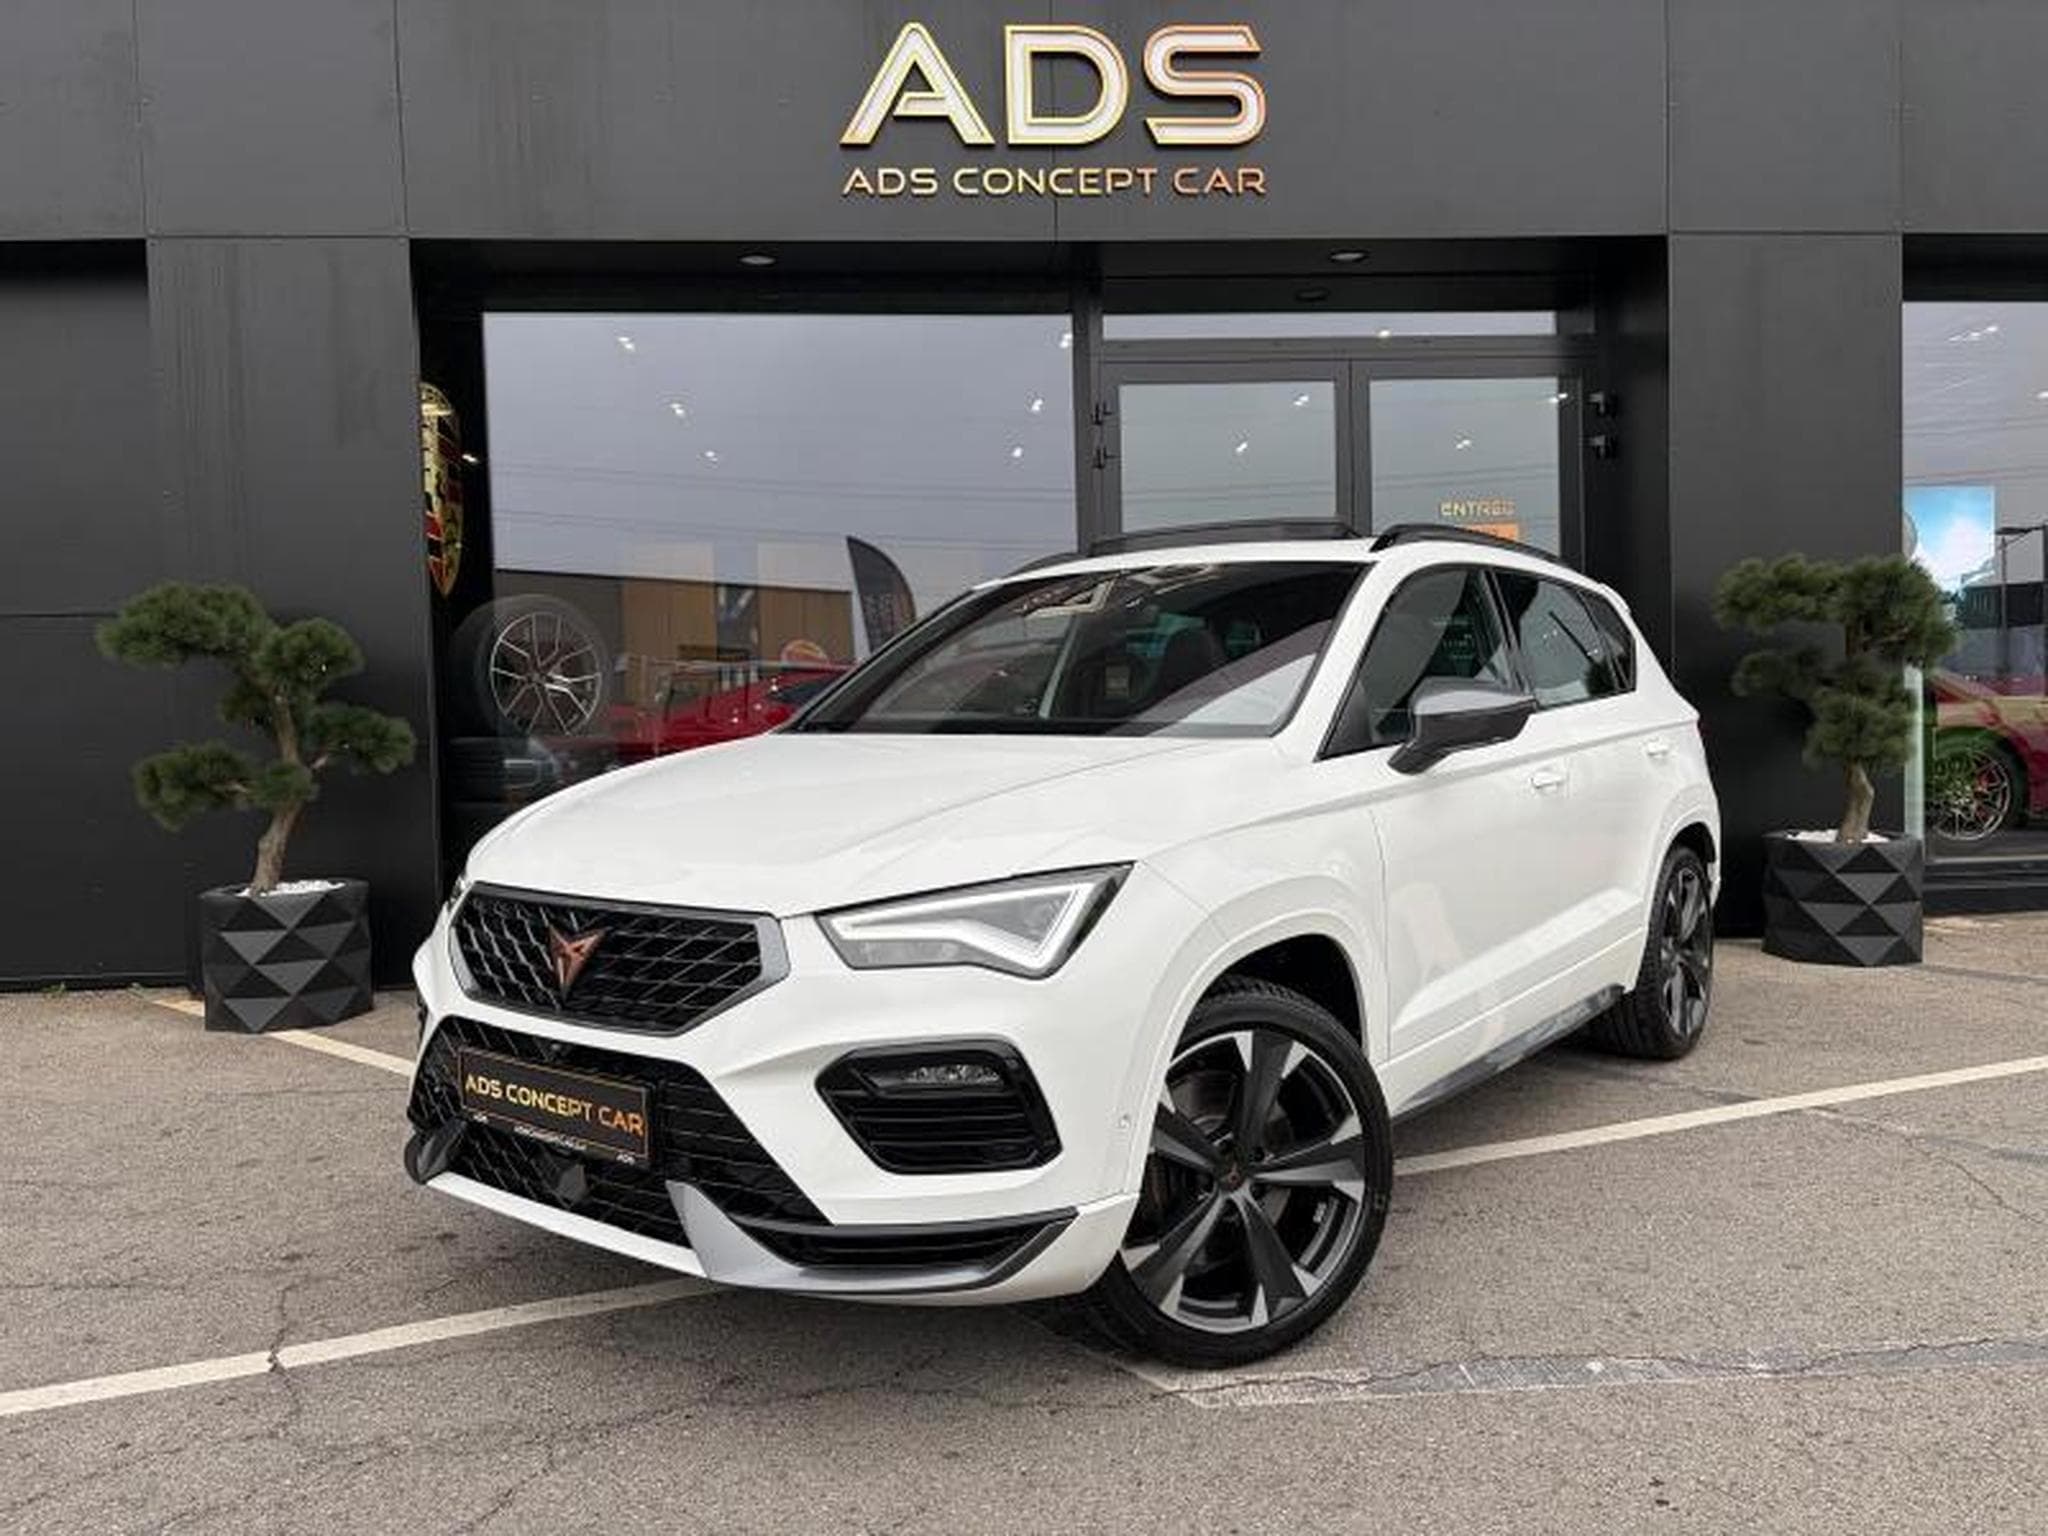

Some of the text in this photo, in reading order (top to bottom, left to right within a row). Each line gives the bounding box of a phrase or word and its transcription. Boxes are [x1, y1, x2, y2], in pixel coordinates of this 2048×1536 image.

[839, 21, 1267, 146] ADS
[841, 167, 1267, 195] ADS CONCEPT CAR
[465, 1074, 502, 1099] ADS
[505, 1084, 593, 1121] CONCEPT
[598, 1106, 644, 1136] CAR
